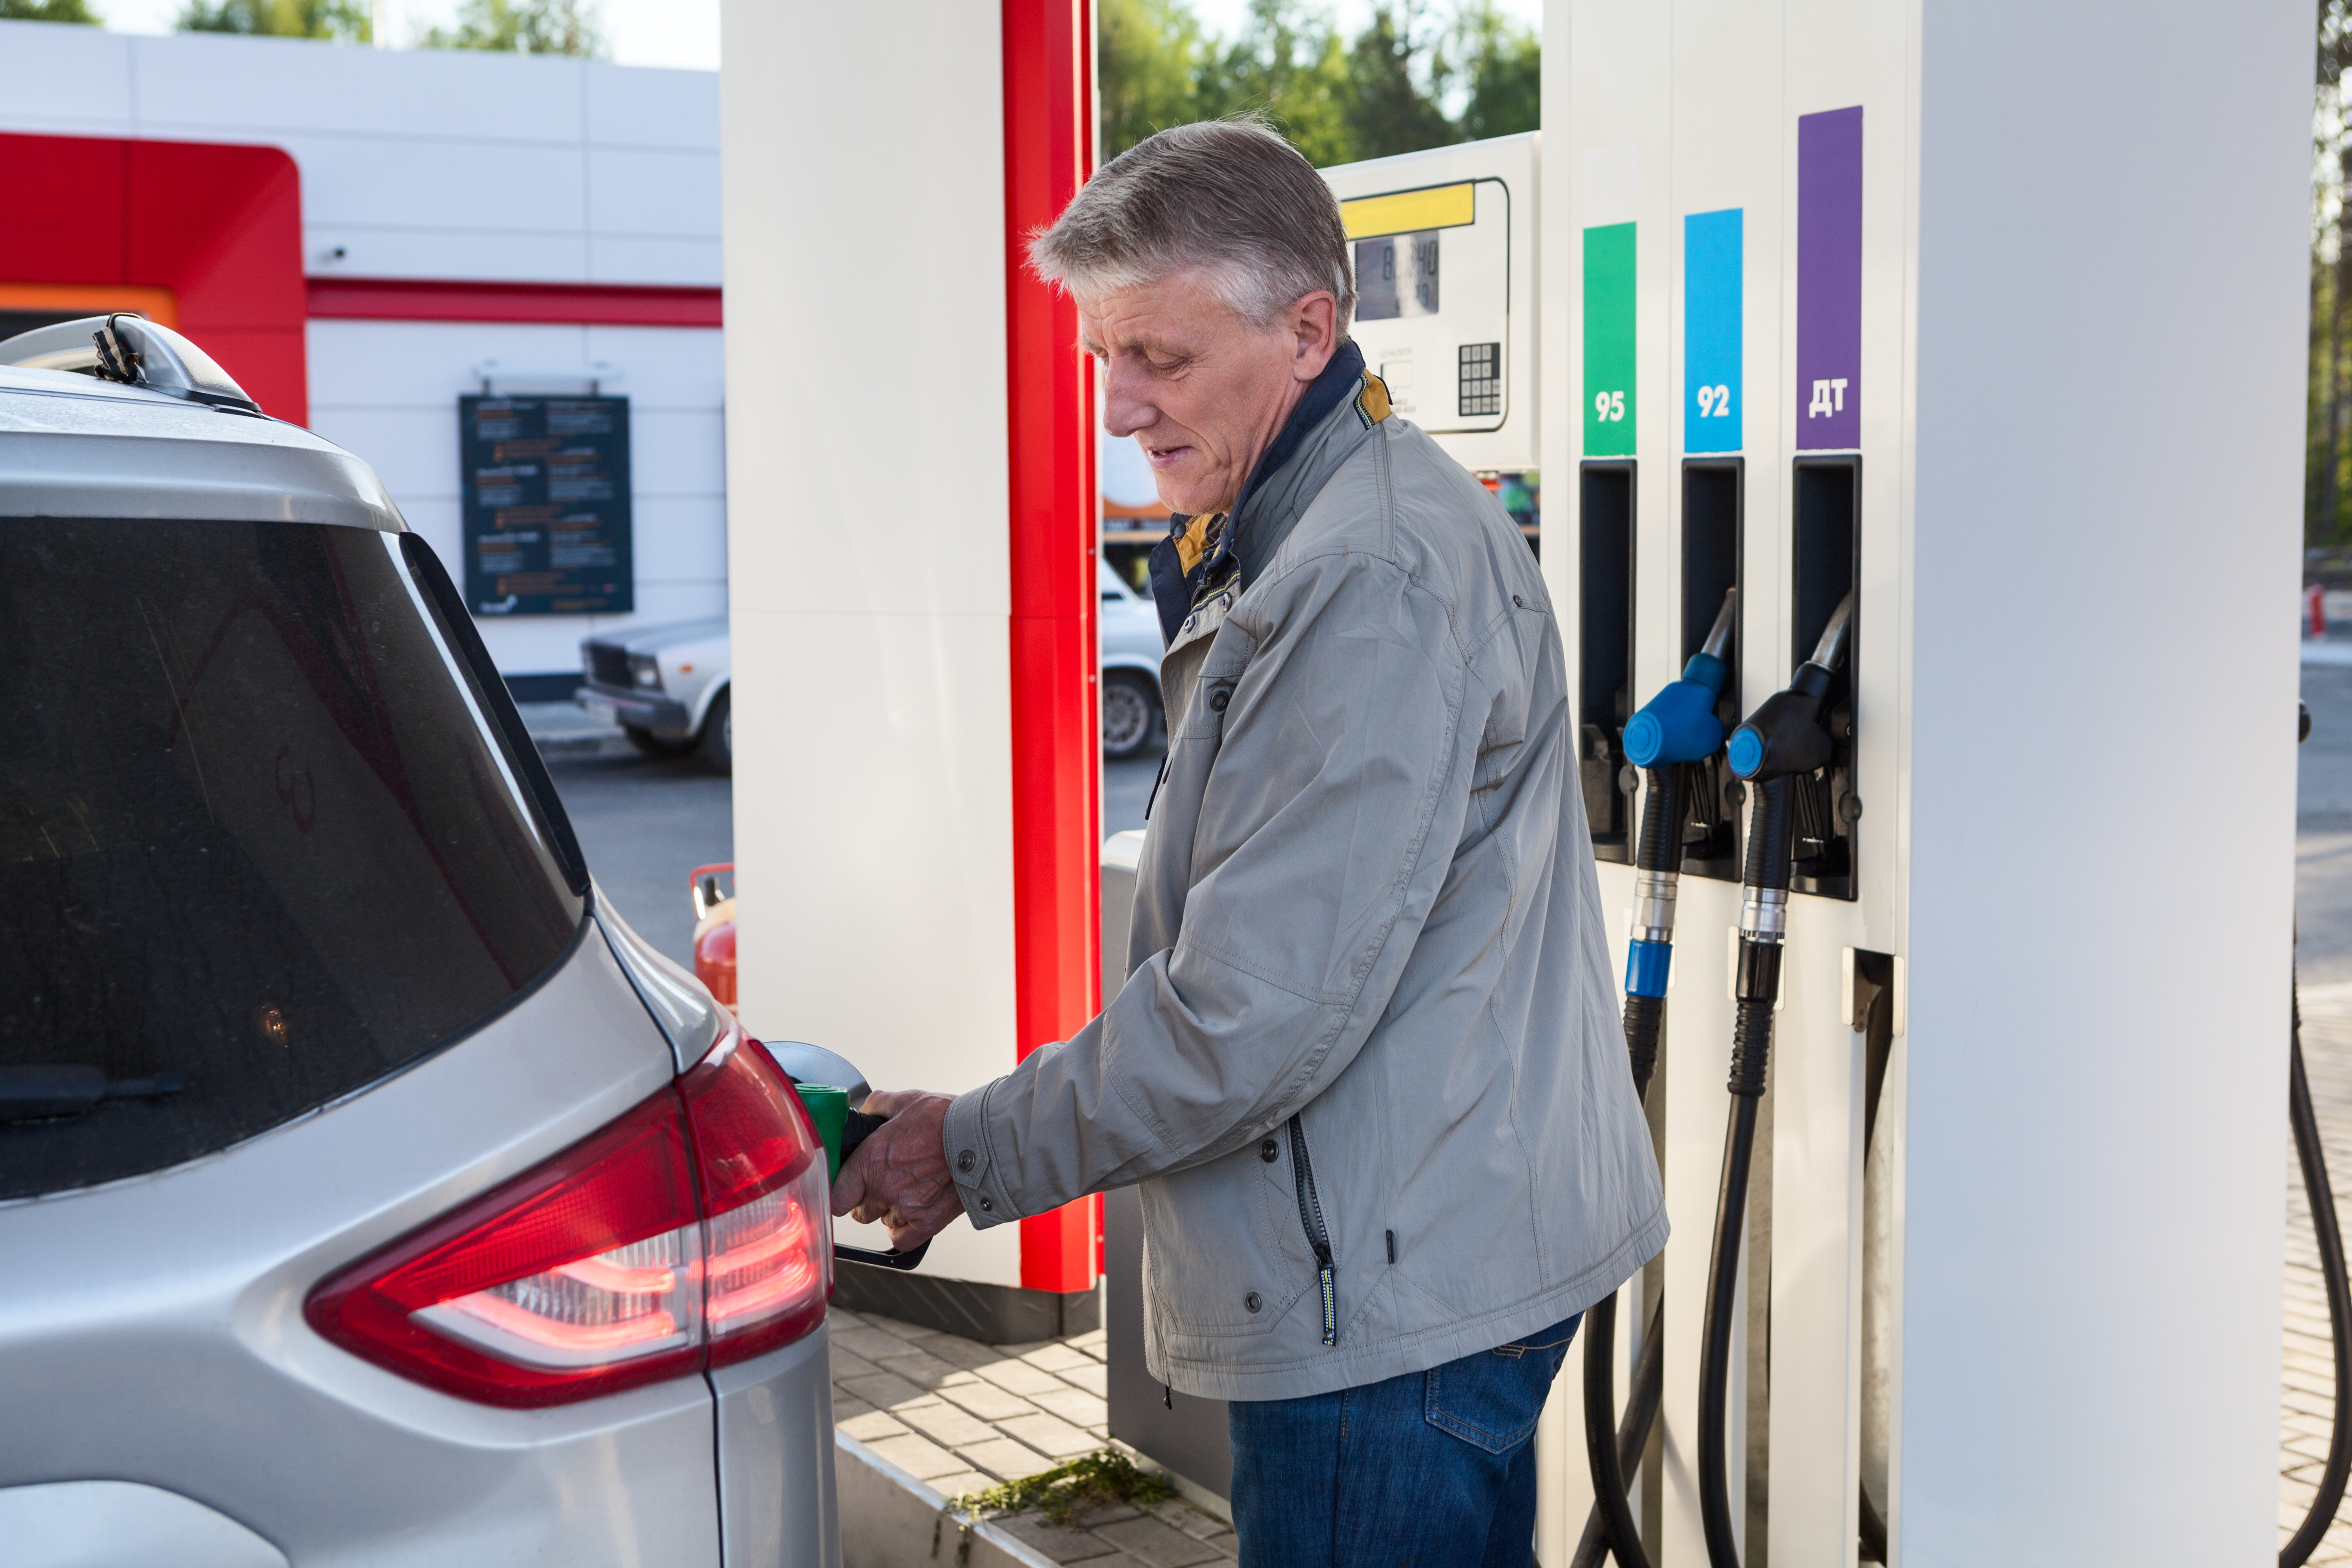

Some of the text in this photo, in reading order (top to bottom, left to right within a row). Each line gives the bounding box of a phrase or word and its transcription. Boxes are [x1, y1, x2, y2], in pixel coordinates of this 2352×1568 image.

[1595, 390, 1625, 422] 95
[1697, 384, 1730, 417] 92
[1809, 378, 1848, 418] ДТ
